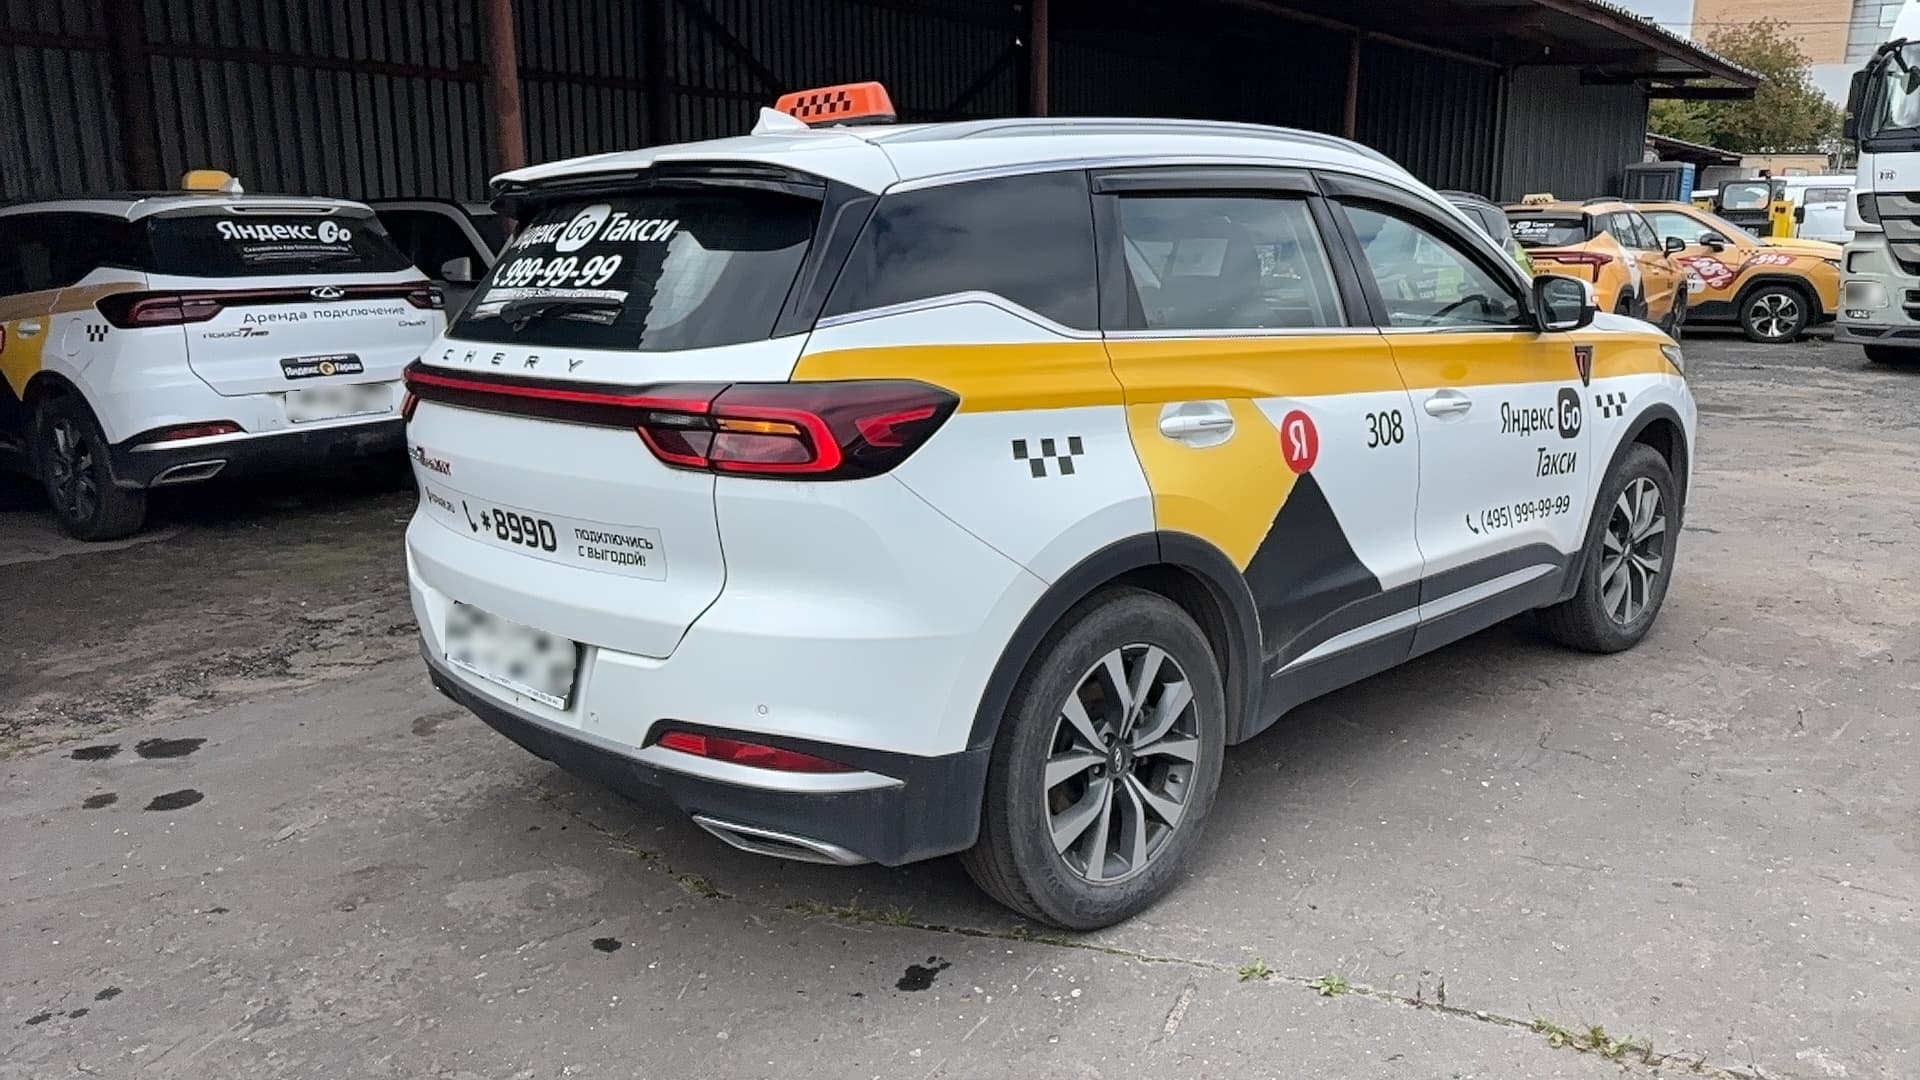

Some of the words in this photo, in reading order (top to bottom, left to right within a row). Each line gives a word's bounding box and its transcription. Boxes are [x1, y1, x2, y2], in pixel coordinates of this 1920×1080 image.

[216, 220, 318, 241] Яндекс
[318, 220, 352, 243] Go
[600, 212, 680, 242] Такси
[499, 254, 623, 287] 999-99-99
[243, 311, 308, 325] Аренда
[313, 306, 406, 321] подключение
[443, 348, 584, 372] CHERY
[1365, 409, 1404, 448] 308
[1501, 401, 1554, 437] Яндекс
[1288, 419, 1309, 461] Я
[1536, 447, 1577, 477] Такси
[1480, 505, 1514, 535] (495)
[1514, 495, 1570, 523] 999-99-99
[574, 528, 654, 550] ПОДКЛЮЧИСЬ
[578, 545, 585, 557] С
[587, 546, 646, 566] ВЫГОДОЙ!
